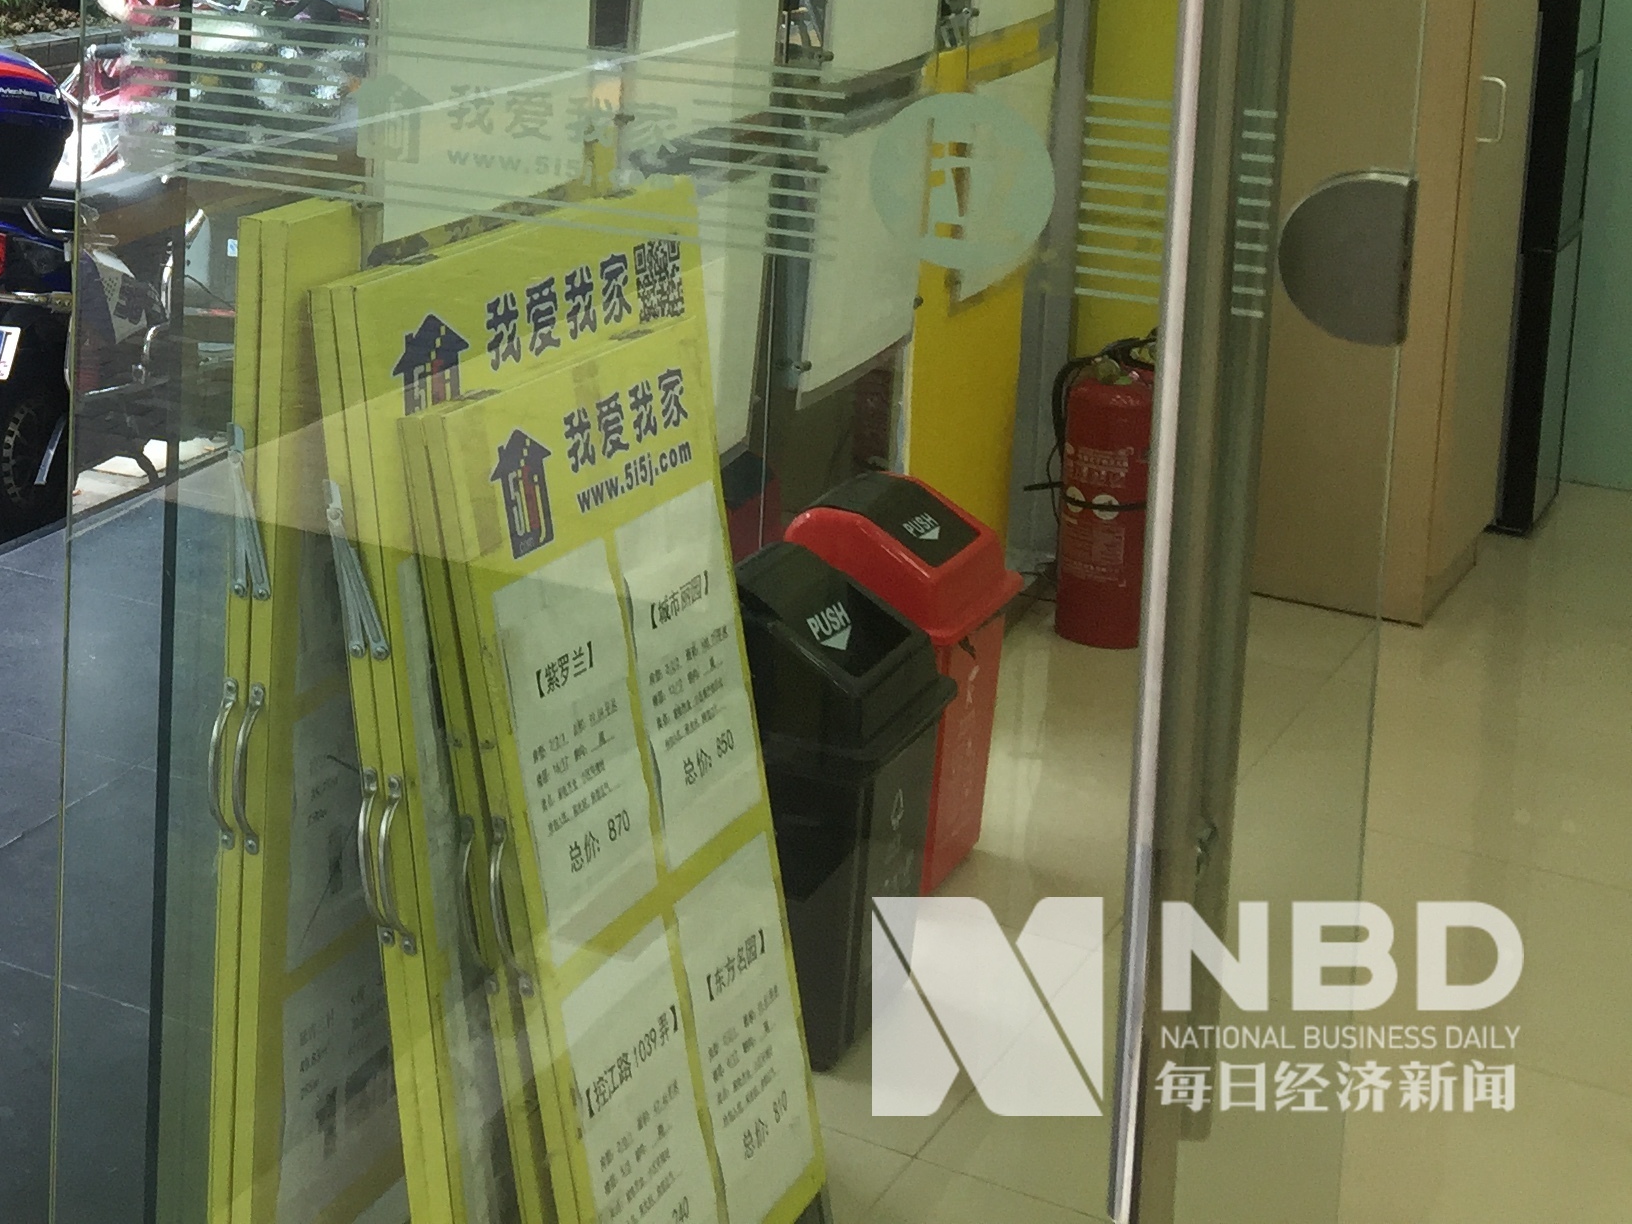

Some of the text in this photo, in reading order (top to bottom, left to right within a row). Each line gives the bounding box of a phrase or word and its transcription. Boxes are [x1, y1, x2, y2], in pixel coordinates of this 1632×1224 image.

[486, 254, 633, 371] 我爱我家
[563, 368, 689, 473] 我爱我家
[576, 440, 693, 514] www.5i5j.com
[902, 512, 939, 537] PUSH
[806, 602, 852, 642] PUSH
[607, 809, 631, 842] 870
